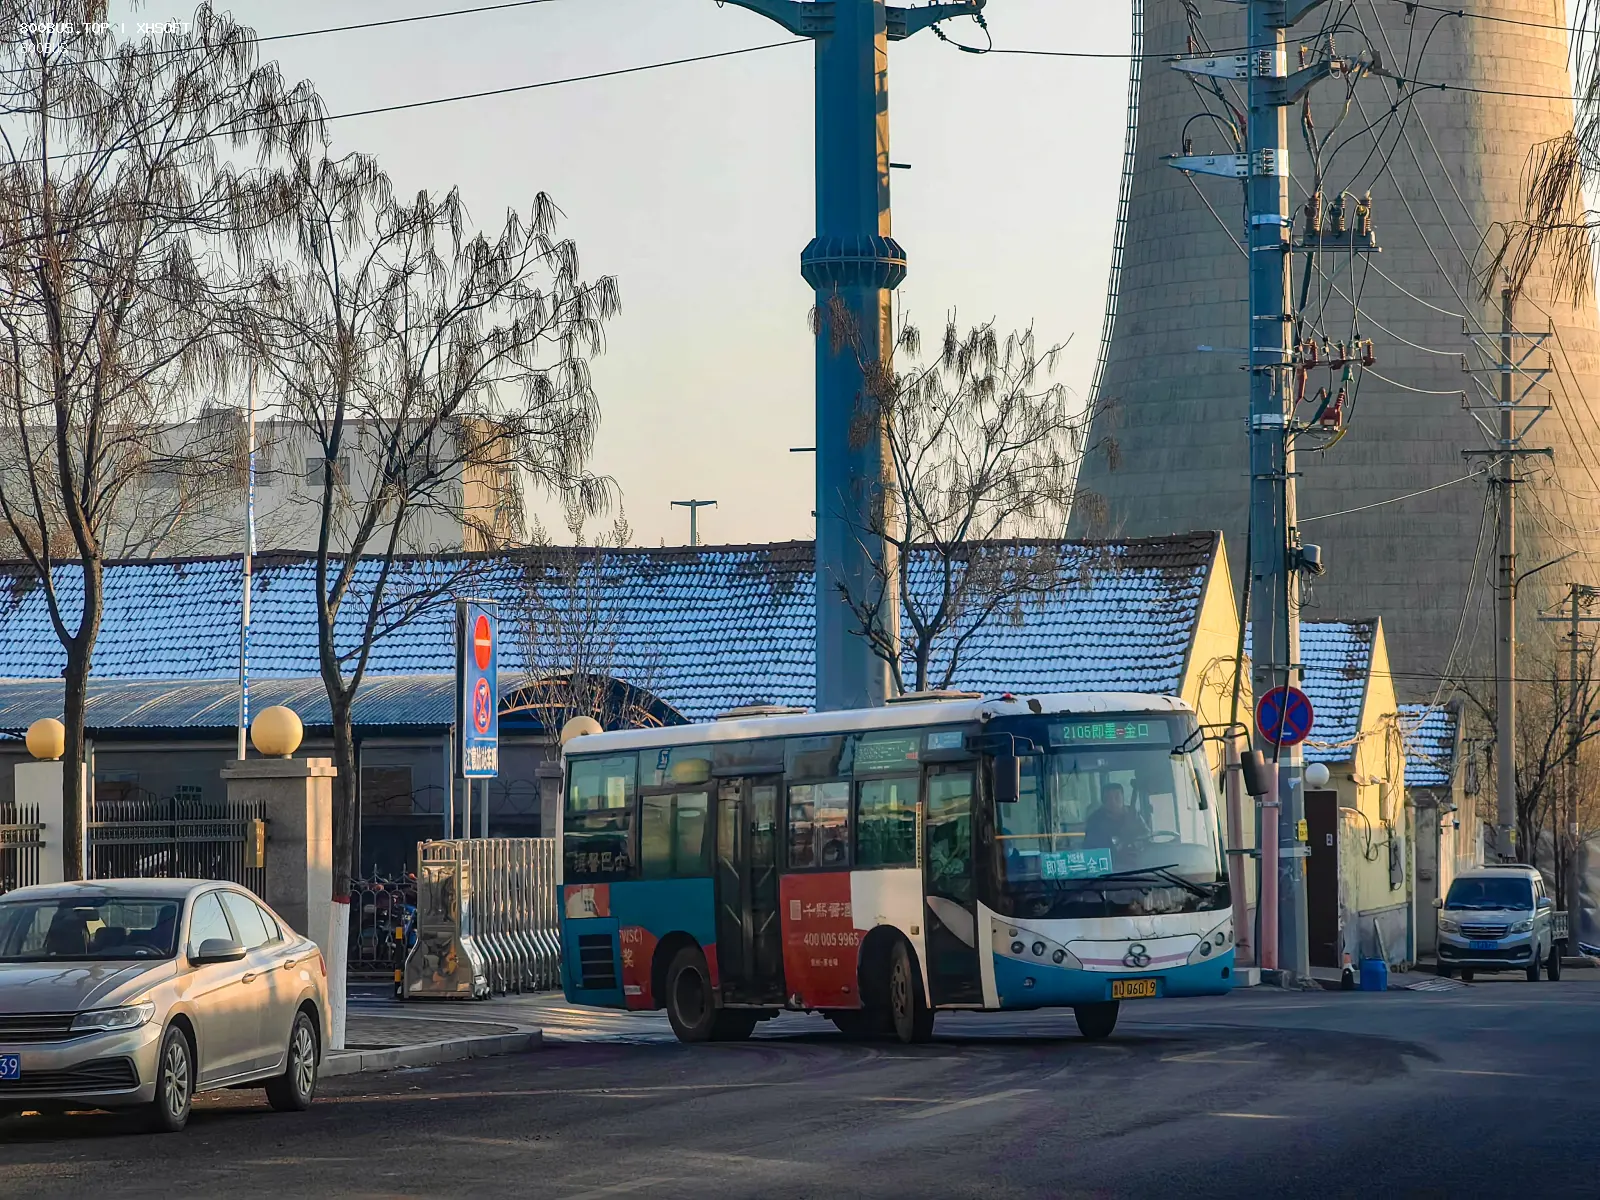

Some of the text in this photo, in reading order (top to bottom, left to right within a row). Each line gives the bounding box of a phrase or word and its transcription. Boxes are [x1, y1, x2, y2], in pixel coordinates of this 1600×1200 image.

[804, 933, 820, 947] 400
[821, 933, 837, 947] 005
[838, 932, 860, 947] 9965
